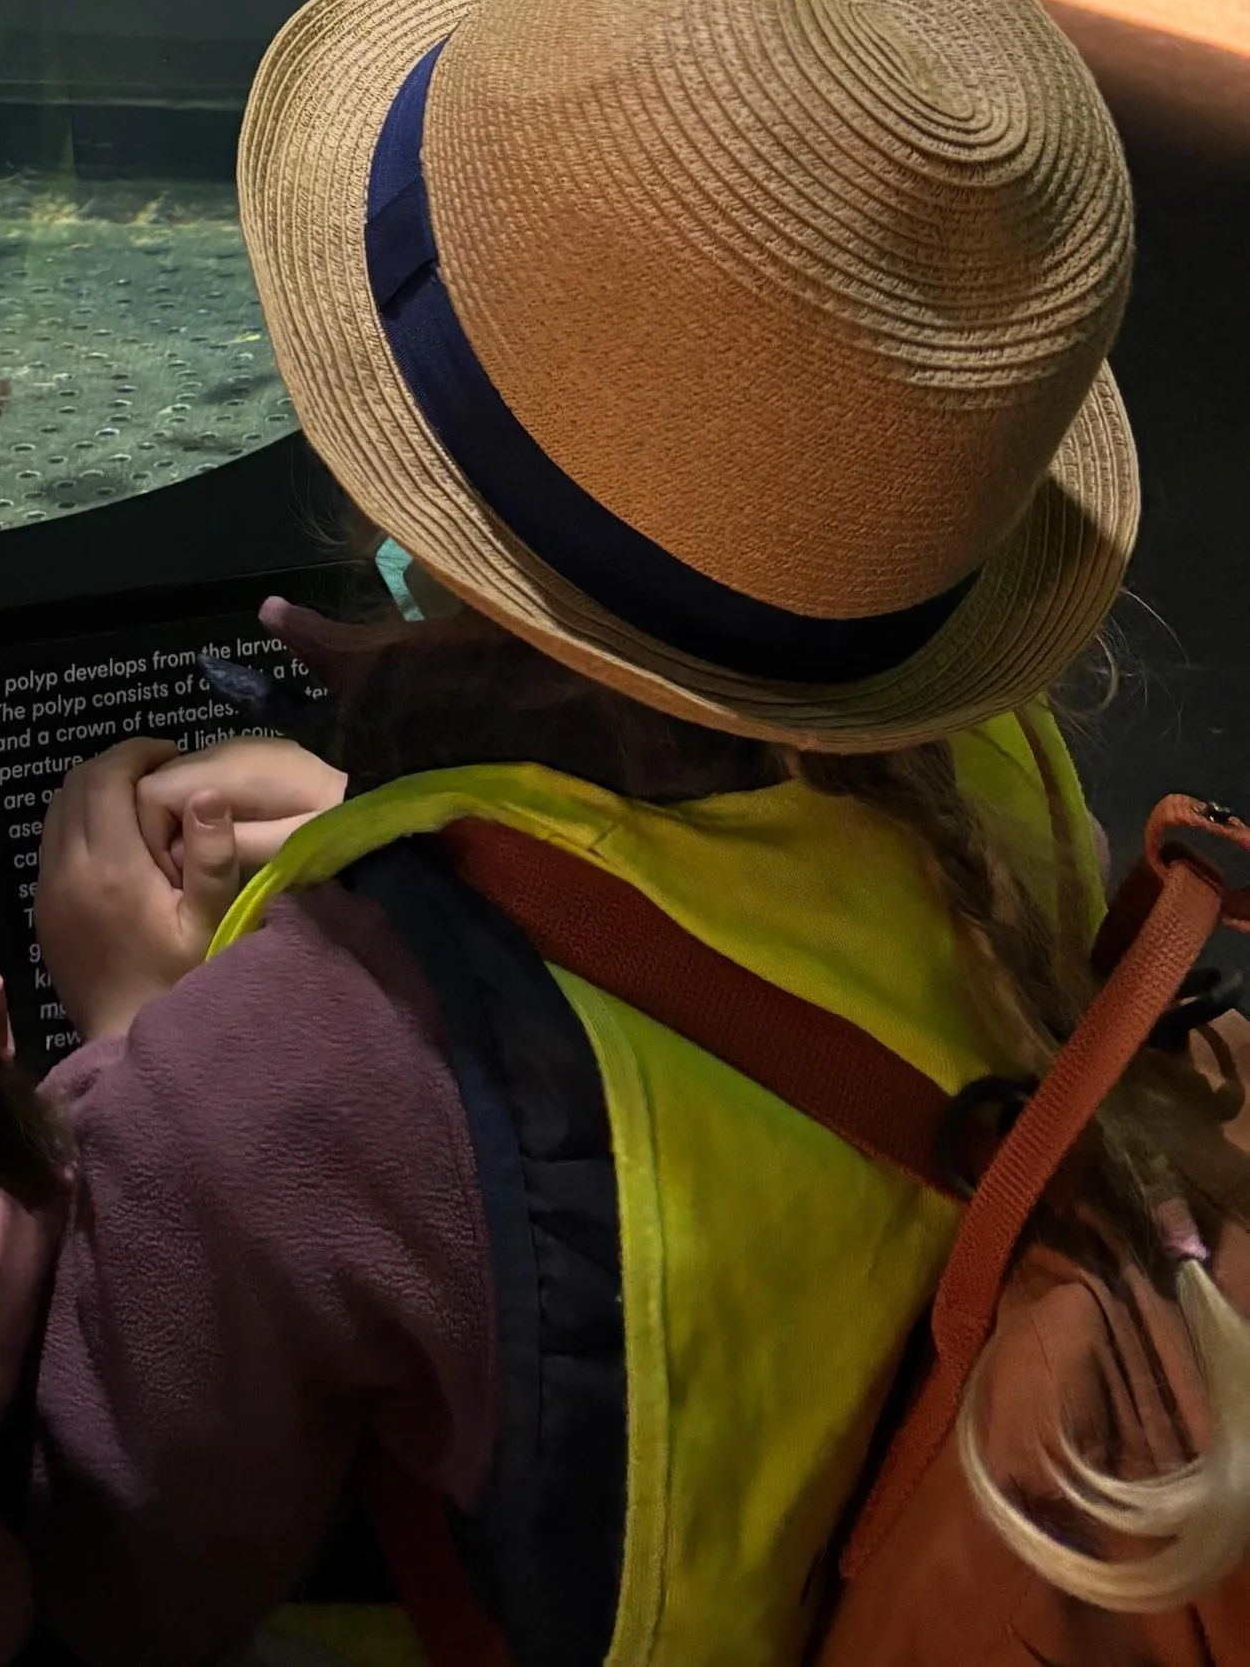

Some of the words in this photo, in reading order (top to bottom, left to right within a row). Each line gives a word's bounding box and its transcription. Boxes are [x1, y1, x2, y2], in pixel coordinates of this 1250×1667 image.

[5, 669, 58, 697] polyp
[64, 657, 147, 683] develops
[152, 650, 196, 670] from
[202, 642, 231, 660] the
[237, 638, 288, 657] larva.
[32, 694, 86, 722] polyp
[92, 682, 169, 708] consists
[175, 674, 194, 695] of
[273, 665, 285, 679] a
[37, 731, 49, 745] a
[56, 720, 116, 742] crown
[123, 711, 142, 732] of
[147, 699, 240, 728] tentacles.
[3, 791, 36, 810] are
